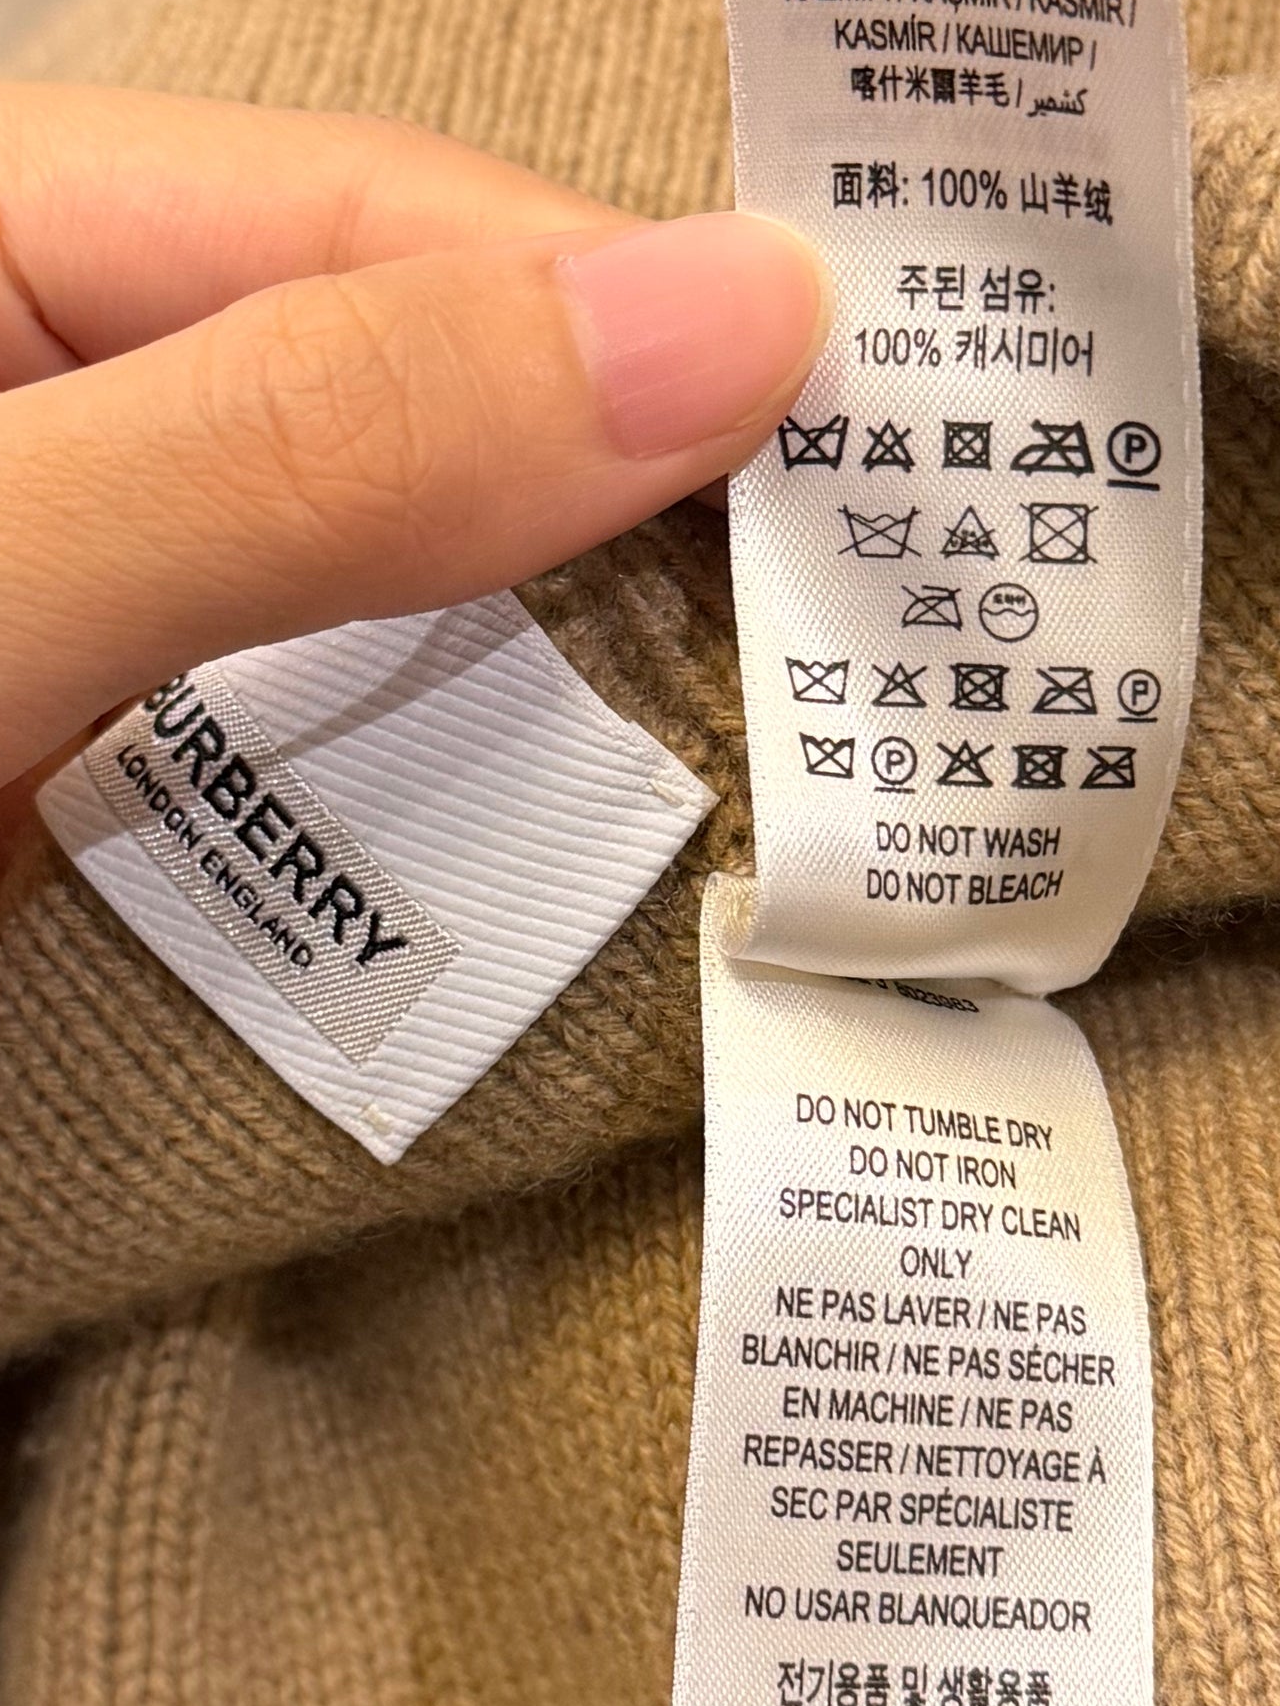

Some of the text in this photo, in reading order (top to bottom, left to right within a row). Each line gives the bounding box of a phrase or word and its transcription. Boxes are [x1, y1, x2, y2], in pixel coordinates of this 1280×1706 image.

[835, 14, 1097, 70] KASMÍR / КАШЕМИР /
[922, 168, 1007, 210] 100%
[1021, 171, 1113, 225] 山羊绒
[897, 264, 1055, 314] 주된 섬유:
[855, 324, 1093, 376] 100% 캐시미어
[117, 743, 313, 969] LONDON ENGLAND
[876, 821, 1061, 858] DO NOT WASH
[867, 868, 1064, 905] DO NOT BLEACH
[796, 1093, 1052, 1150] DO NOT TUMBLE DRY
[849, 1145, 1016, 1190] DO NOT IRON
[779, 1187, 1082, 1242] SPECIALIST DRY CLEAN
[900, 1246, 972, 1279] ONLY
[776, 1287, 1087, 1336] NE PAS LAVER / NE PAS
[742, 1333, 1116, 1387] BLANCHIR / NE PAS SÉCHER
[783, 1386, 1073, 1433] EN MACHINE / NE PAS
[743, 1434, 1107, 1484] REPASSER / NETTOYAGE À
[770, 1486, 1074, 1532] SEC PAR SPÉCIALISTE
[836, 1540, 1004, 1578] SEULEMENT
[744, 1585, 1092, 1633] NO USAR BLANQUEADOR
